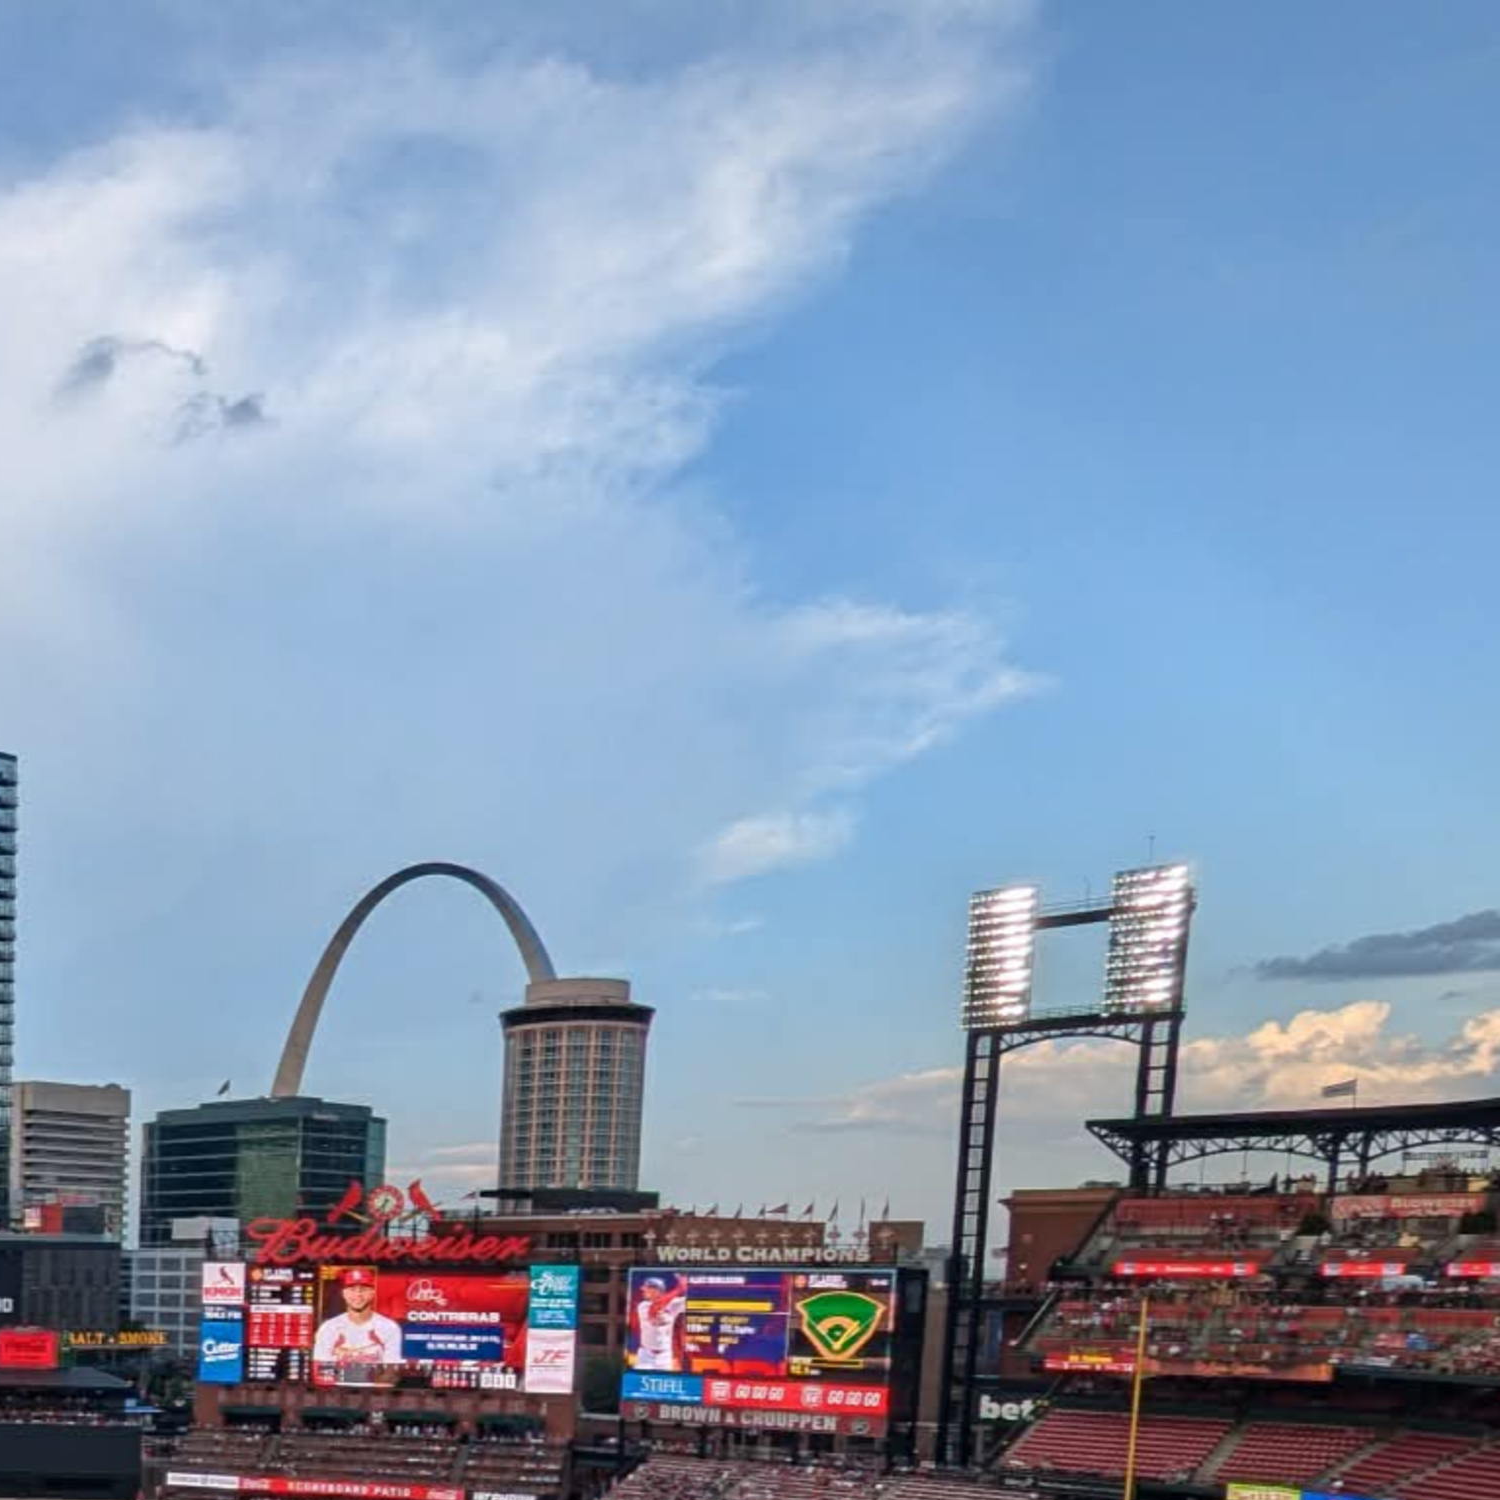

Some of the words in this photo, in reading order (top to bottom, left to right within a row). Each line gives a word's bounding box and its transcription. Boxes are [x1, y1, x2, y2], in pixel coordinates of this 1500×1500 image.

[244, 1217, 531, 1265] Budweiser
[657, 1246, 730, 1262] WORLD
[736, 1247, 871, 1262] CHAMPIONS
[407, 1312, 500, 1322] CONTRERAS
[119, 1332, 168, 1344] SMOKE
[659, 1404, 720, 1423] BROWN
[287, 1481, 369, 1496] SCOREBOARD
[373, 1486, 411, 1498] PATIO
